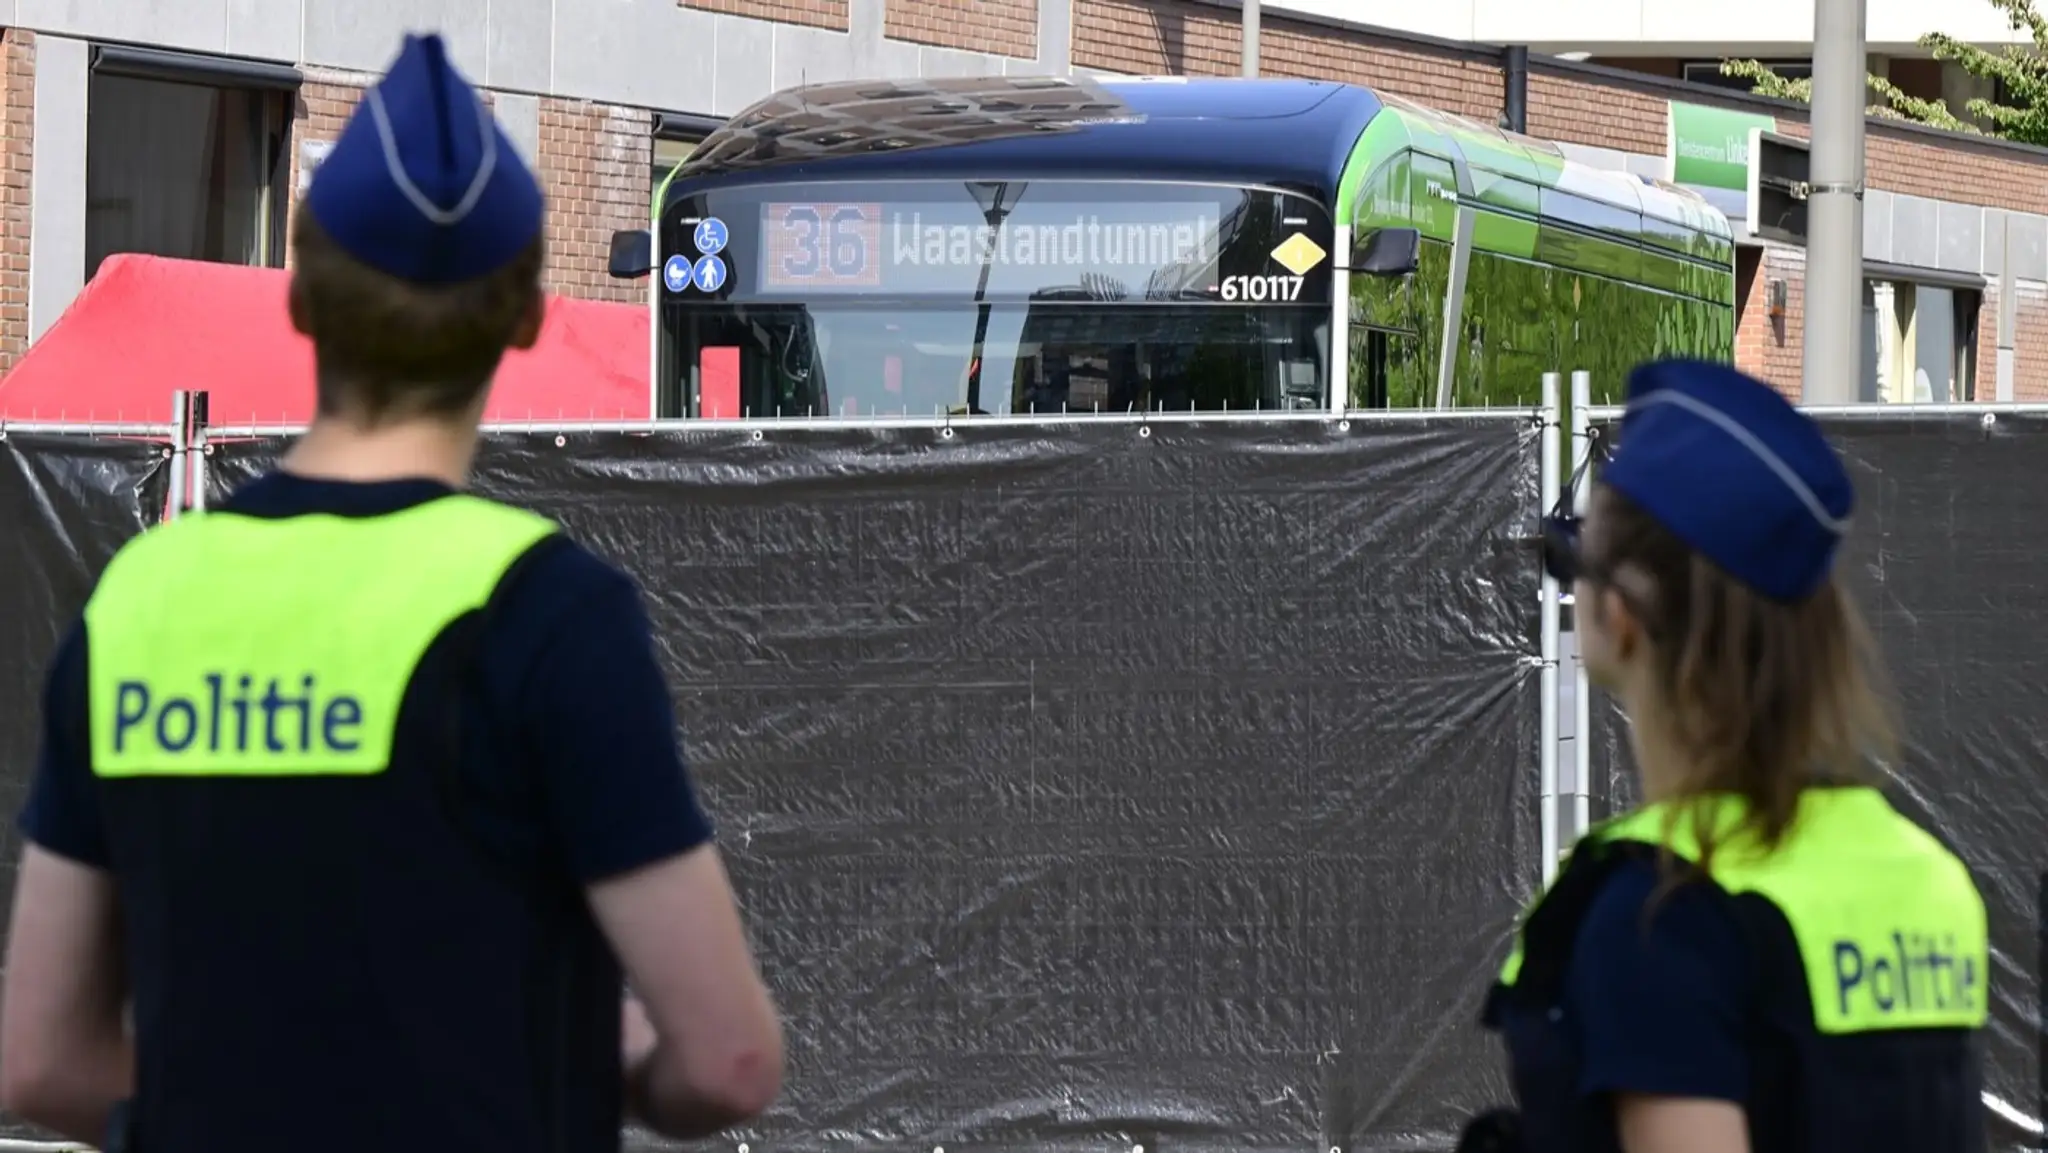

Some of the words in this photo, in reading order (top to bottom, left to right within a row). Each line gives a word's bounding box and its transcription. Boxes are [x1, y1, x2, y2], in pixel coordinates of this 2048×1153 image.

[782, 206, 866, 277] 36
[893, 211, 1208, 265] Waaslandtunnel
[1221, 275, 1304, 300] 610117
[114, 672, 362, 753] Politie
[1834, 931, 1975, 1015] Politie
